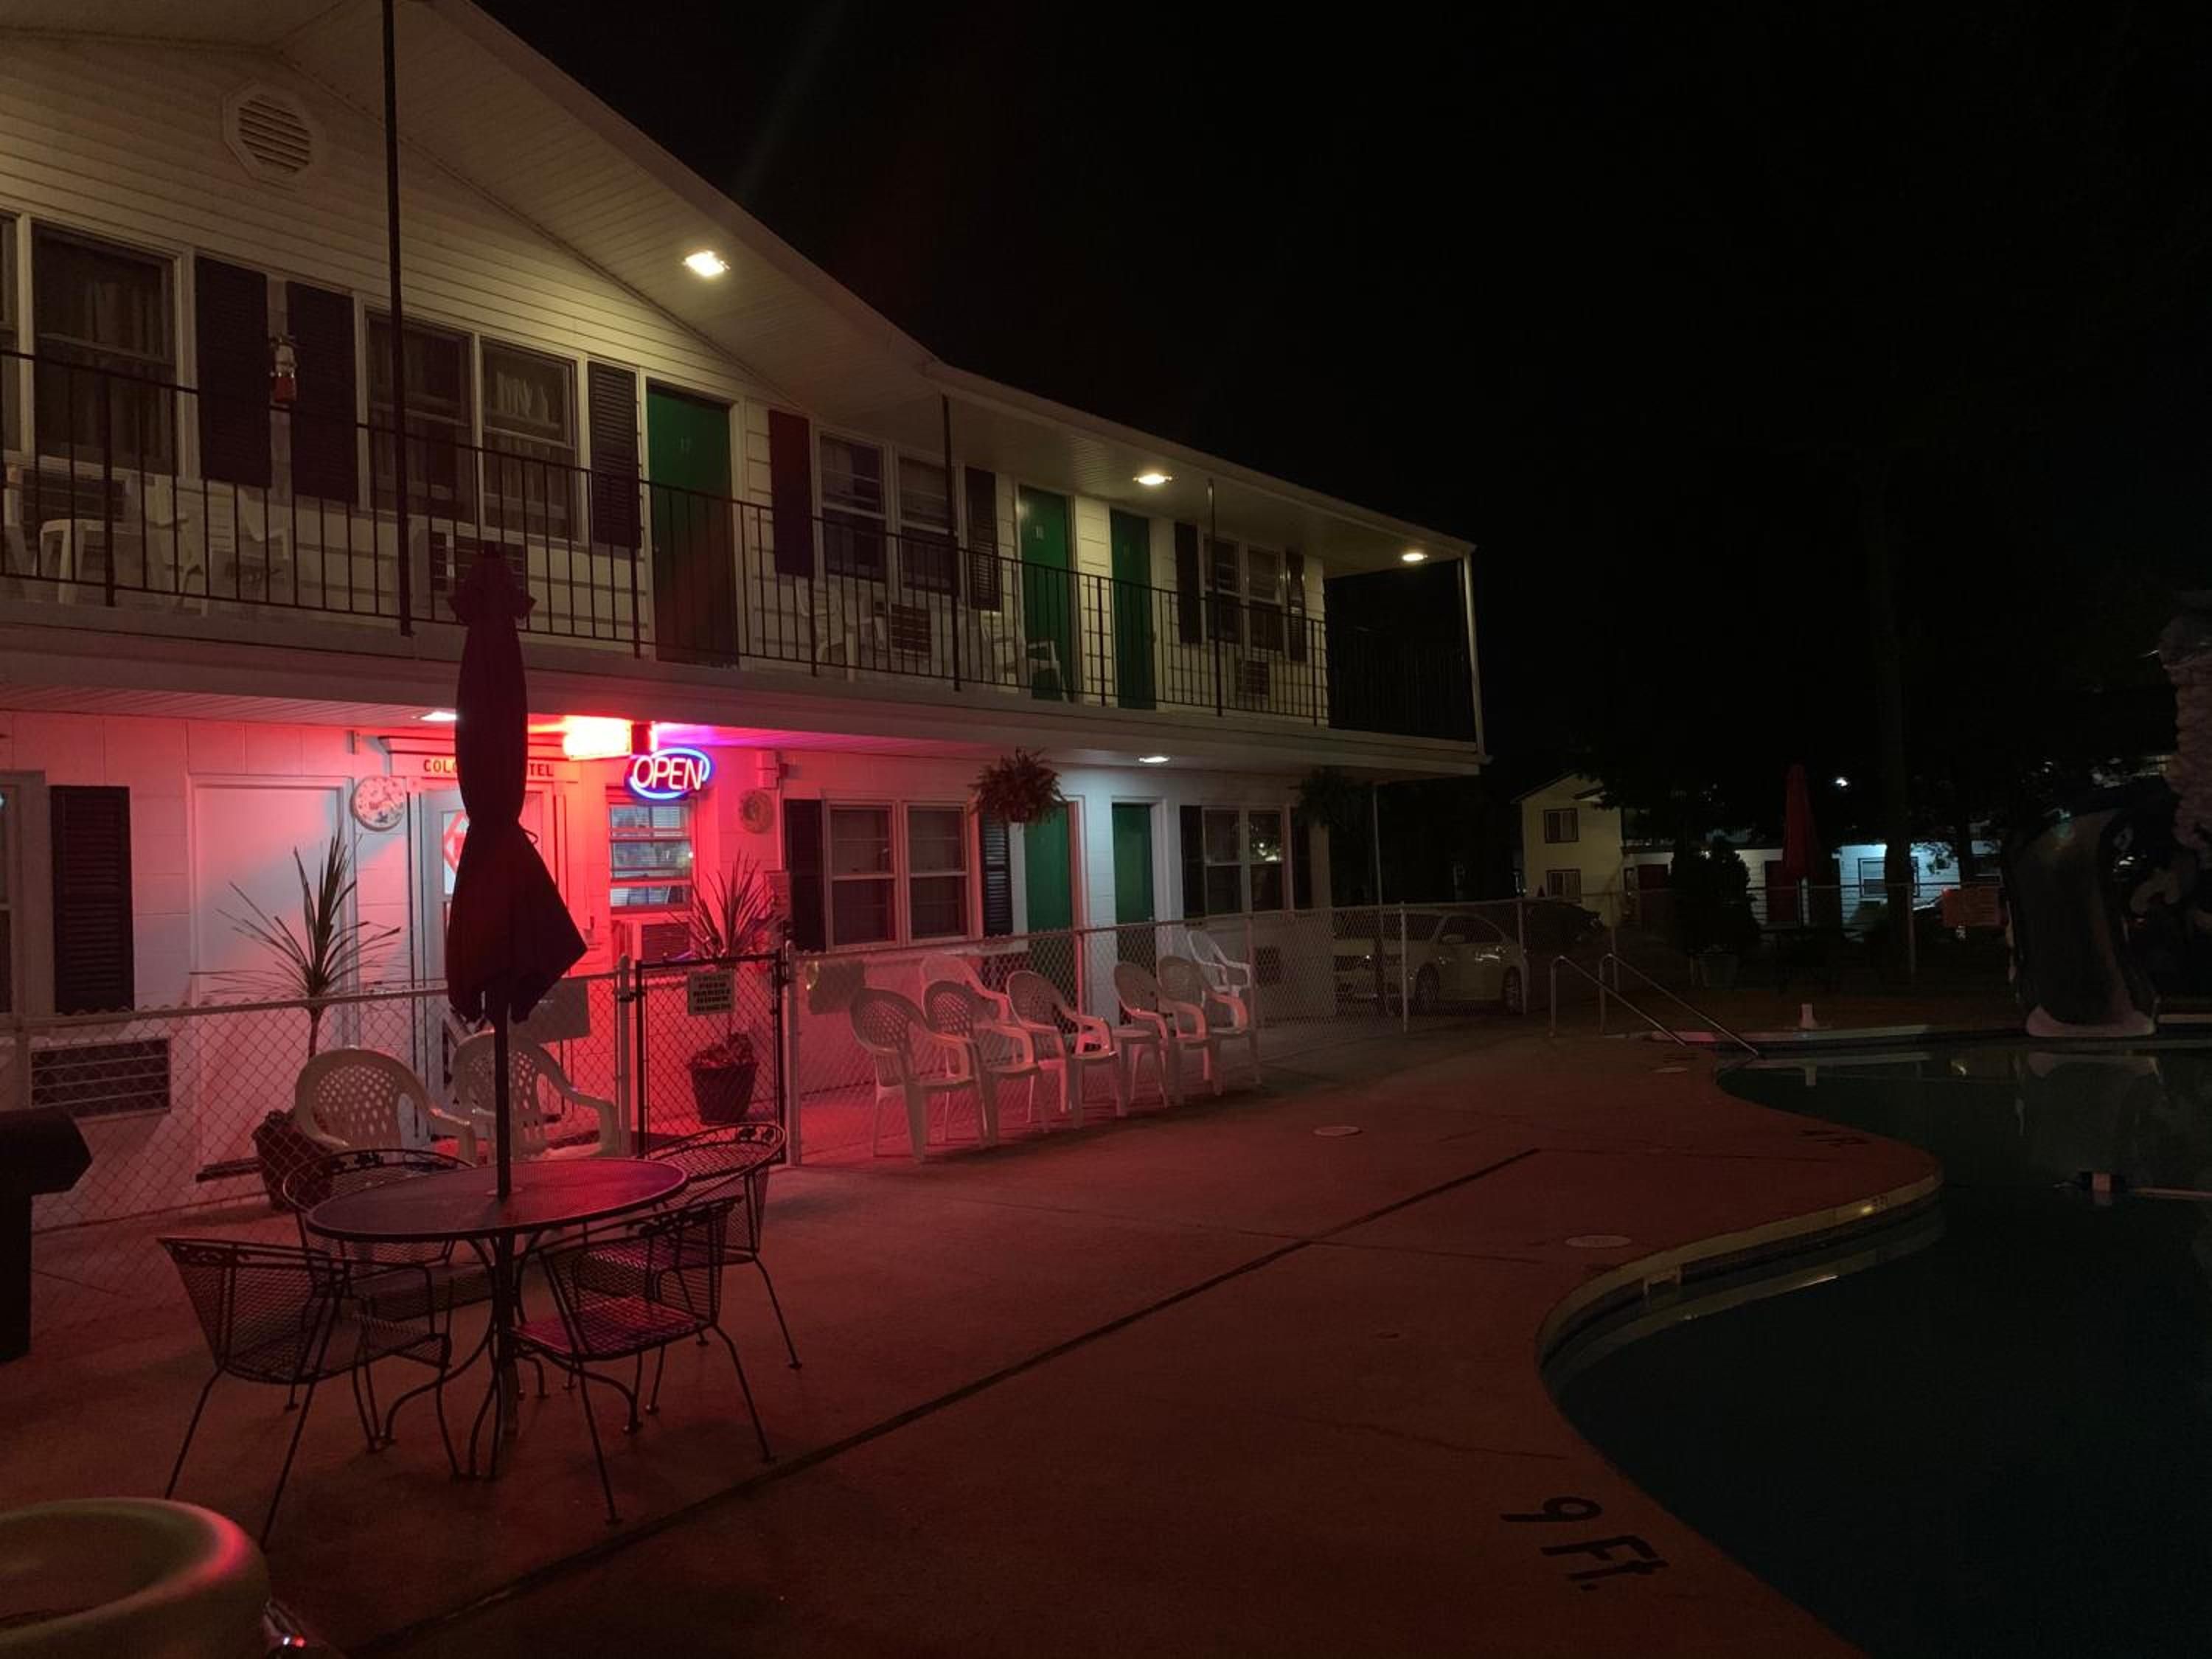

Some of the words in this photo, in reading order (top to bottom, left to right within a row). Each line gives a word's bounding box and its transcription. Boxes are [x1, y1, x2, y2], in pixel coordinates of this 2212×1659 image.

[529, 763, 554, 776] TEL
[633, 754, 703, 790] OPEN
[1500, 1496, 1602, 1523] 9
